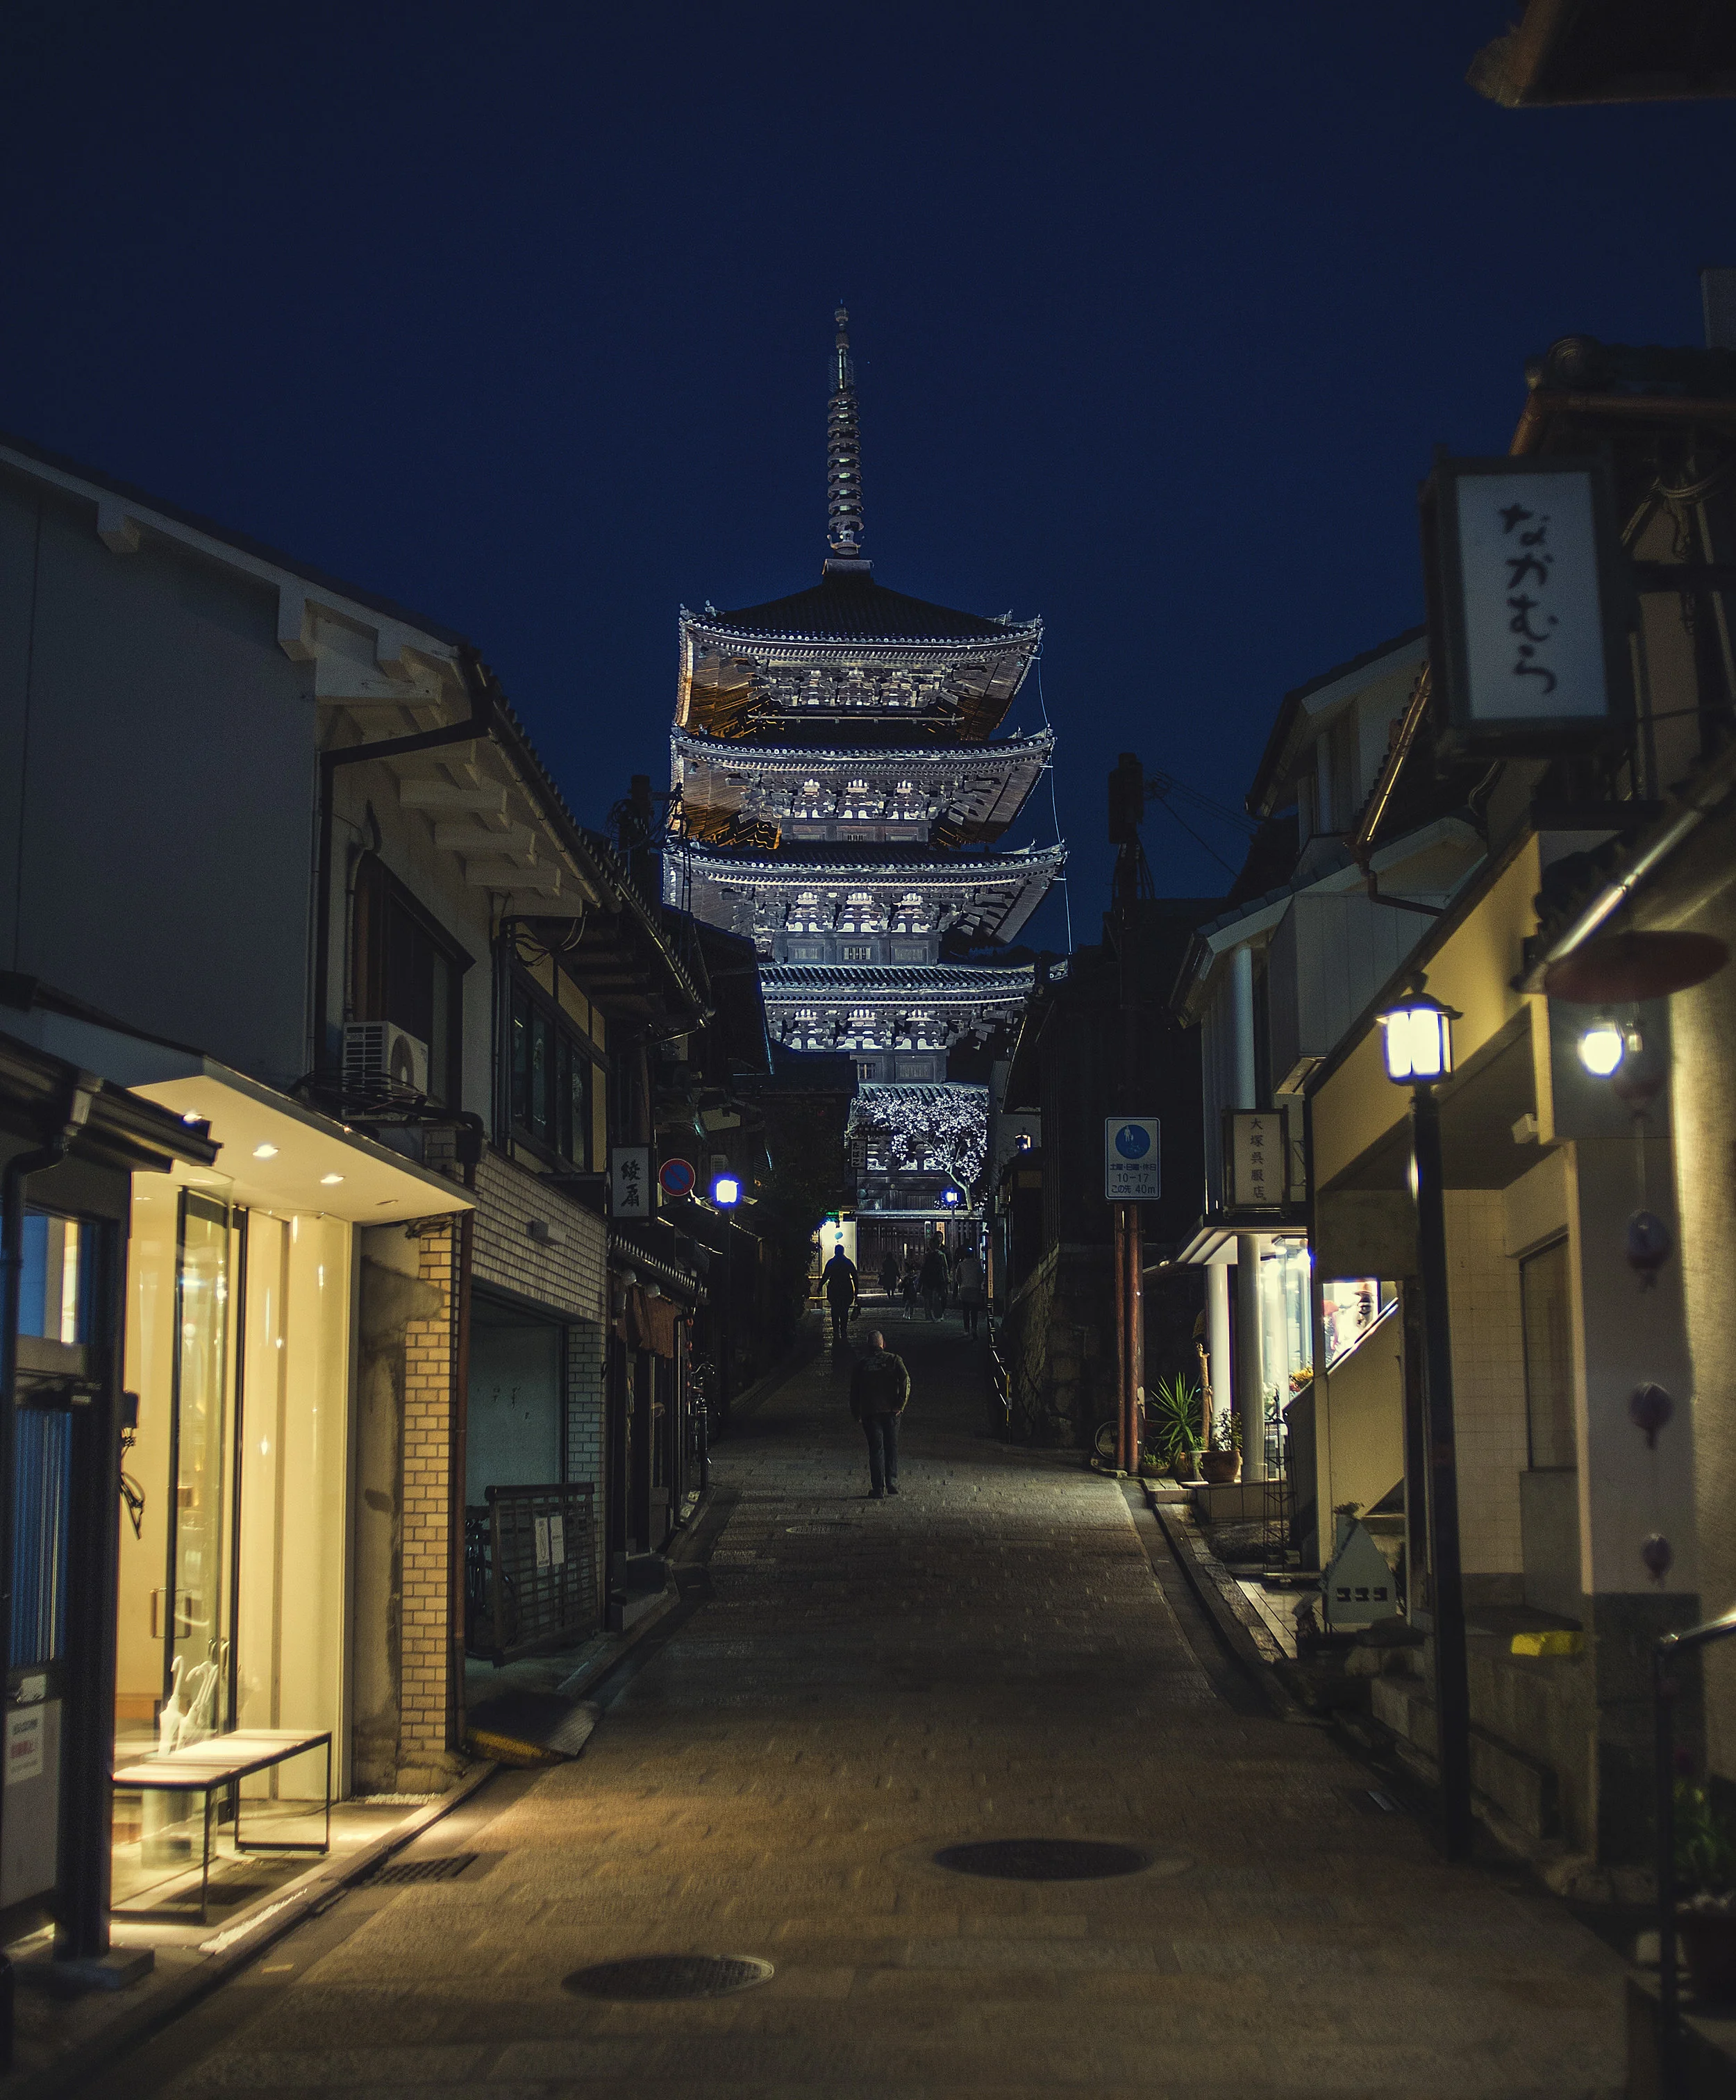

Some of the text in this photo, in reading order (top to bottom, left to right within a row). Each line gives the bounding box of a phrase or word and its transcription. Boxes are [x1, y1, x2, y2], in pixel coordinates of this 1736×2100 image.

[1498, 503, 1559, 693] なかむら
[1111, 1184, 1155, 1194] この先 40m
